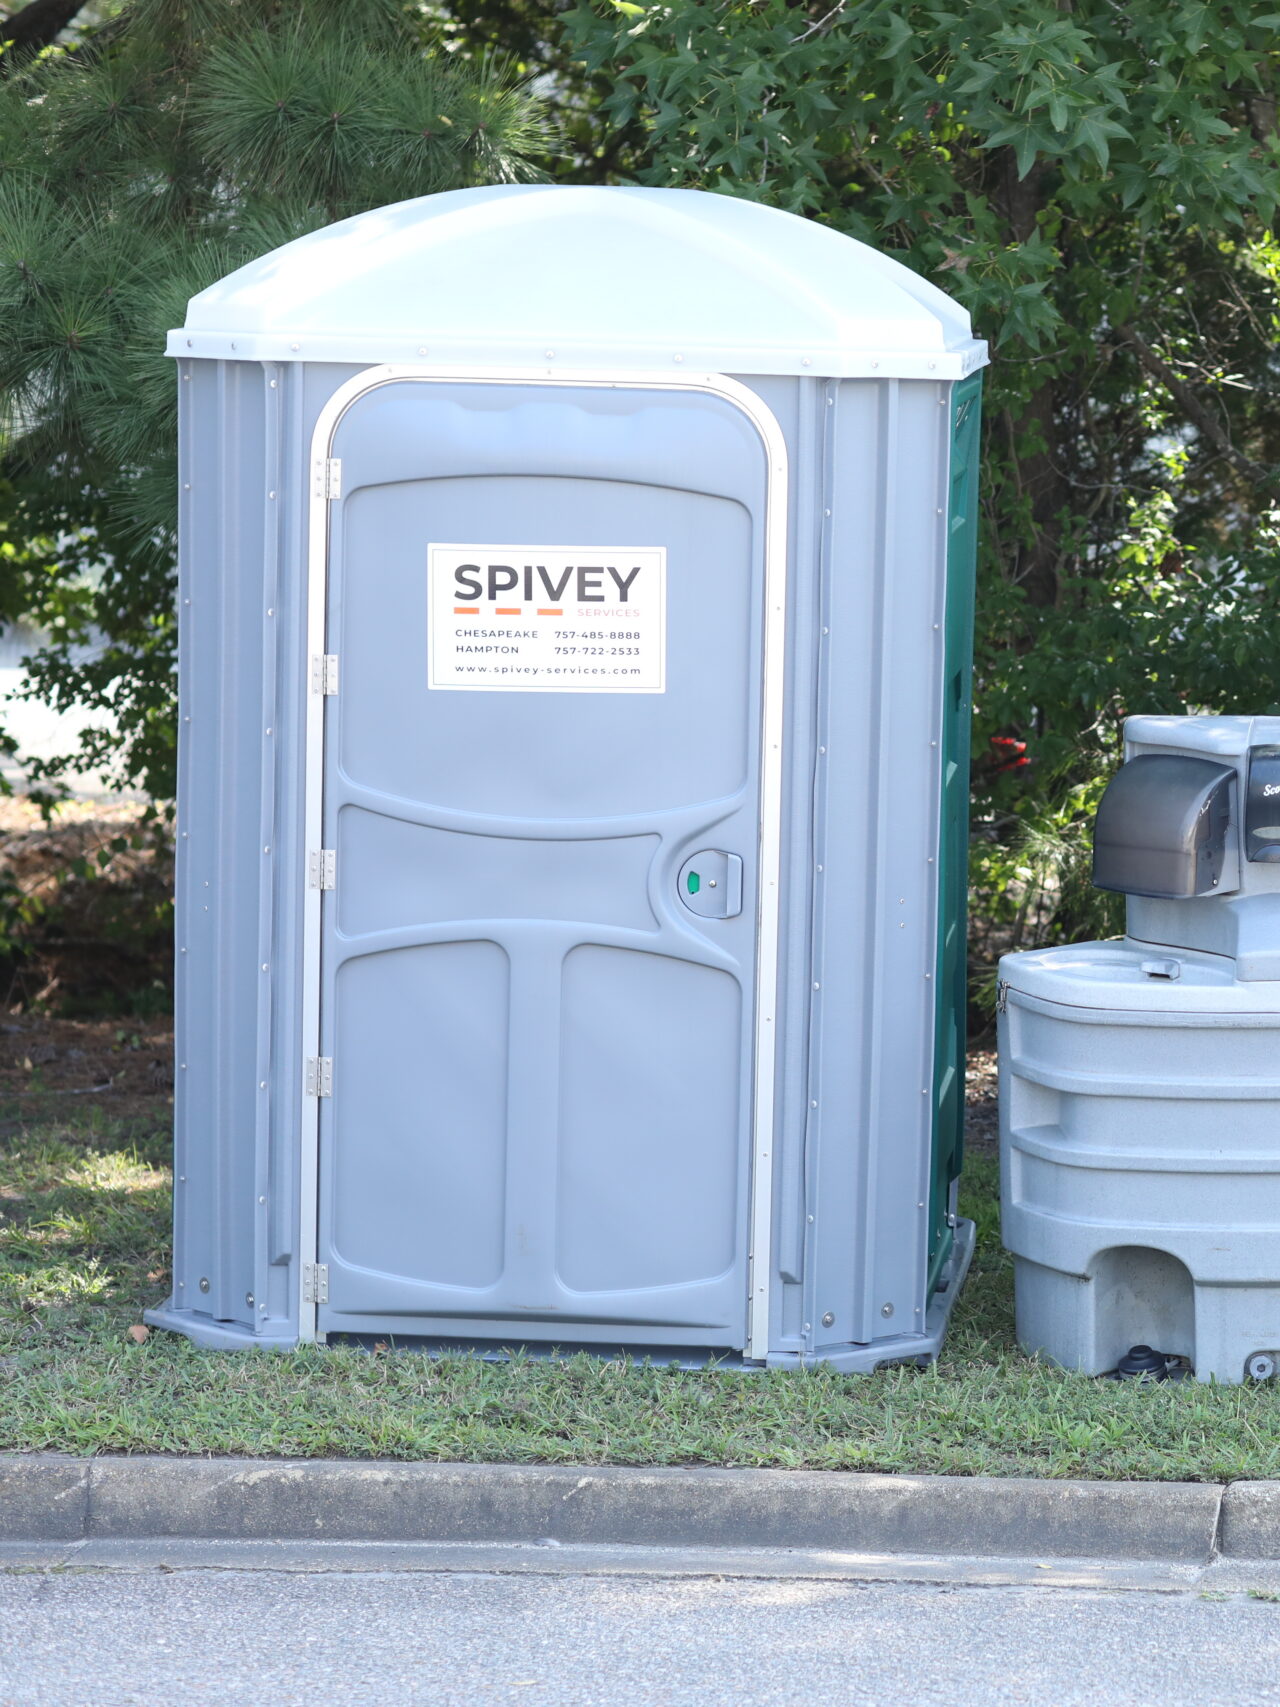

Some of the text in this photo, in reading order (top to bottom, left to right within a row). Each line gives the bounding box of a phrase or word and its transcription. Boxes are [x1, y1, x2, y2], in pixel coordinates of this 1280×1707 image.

[454, 564, 642, 603] SPIVEY
[577, 608, 641, 617] SERVICES
[455, 629, 641, 640] CHESAPEAKE 757-485-8888
[455, 644, 640, 656] HAMPTON 757-722-2533
[455, 664, 641, 676] www.spivey-services.com
